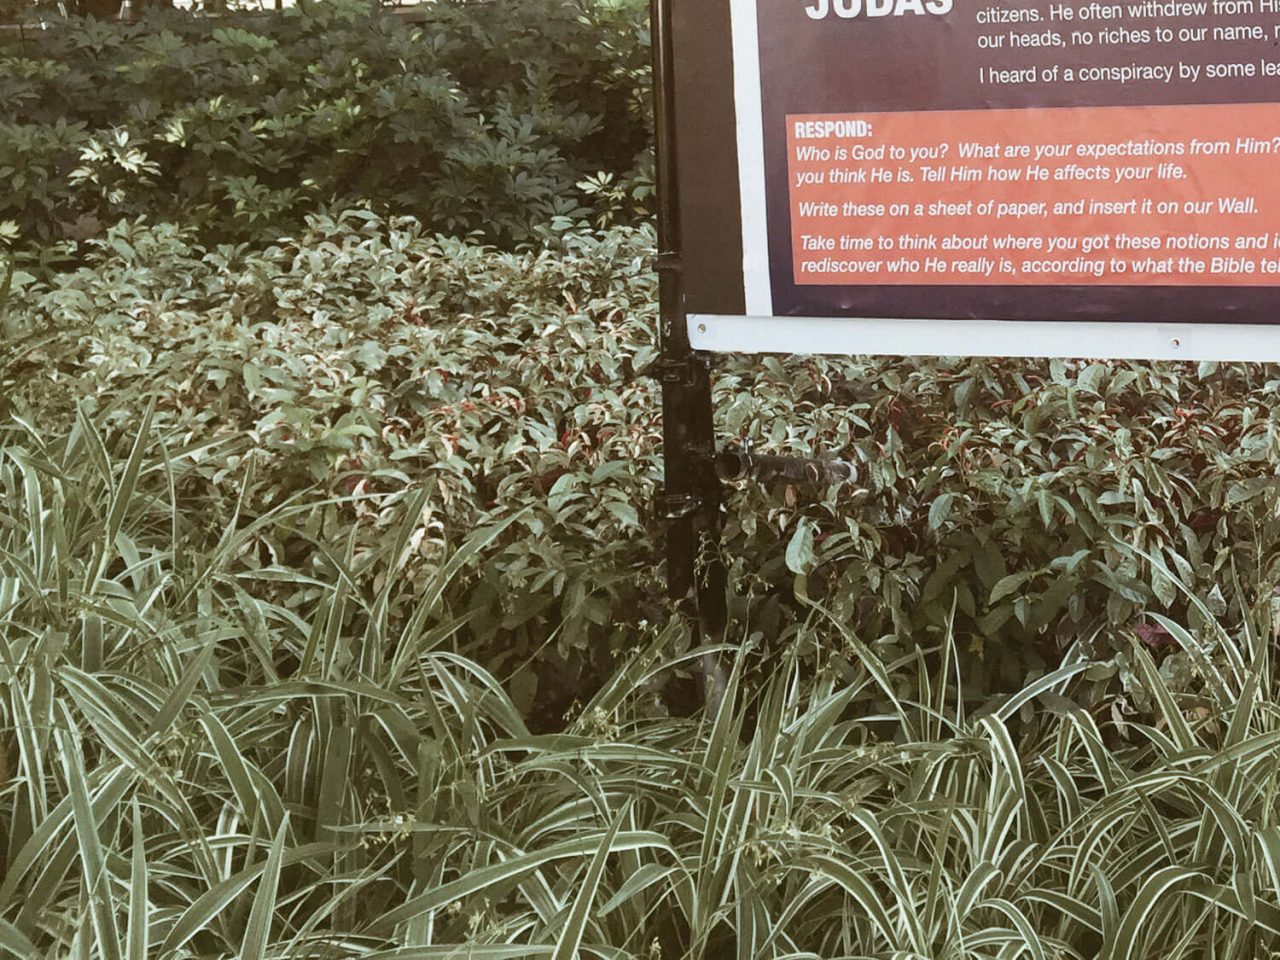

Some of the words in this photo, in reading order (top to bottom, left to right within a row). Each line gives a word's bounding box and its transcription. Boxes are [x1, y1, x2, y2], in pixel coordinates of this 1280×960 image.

[795, 120, 872, 139] RESPOND:
[796, 172, 824, 188] you
[829, 168, 866, 183] think
[870, 167, 893, 182] He
[897, 167, 914, 182] is.
[920, 166, 946, 182] Tell
[950, 166, 982, 182] Him
[987, 165, 1022, 181] how
[1026, 165, 1049, 180] He
[1054, 164, 1110, 180] affects
[1114, 167, 1154, 184] your
[1158, 163, 1187, 179] life.
[799, 202, 838, 217] Write
[842, 202, 885, 216] these
[889, 204, 909, 216] on
[914, 204, 924, 216] a
[928, 200, 973, 216] sheet
[976, 199, 994, 215] of
[997, 202, 1048, 219] paper,
[1053, 199, 1085, 214] and
[1089, 199, 1137, 214] insert
[1141, 198, 1152, 214] it
[1157, 202, 1178, 214] on
[1184, 202, 1214, 214] our
[1218, 197, 1258, 214] Wall.
[800, 235, 835, 250] Take
[840, 234, 873, 250] time
[878, 236, 894, 250] to
[898, 234, 937, 250] think
[942, 234, 989, 250] about
[992, 234, 1042, 249] where
[1047, 237, 1078, 253] you
[1082, 234, 1110, 253] got
[1115, 234, 1161, 249] these
[1166, 233, 1230, 249] notions
[1235, 233, 1268, 249] and
[801, 257, 883, 273] rediscover
[886, 257, 920, 272] who
[924, 257, 947, 272] He
[951, 257, 995, 276] really
[999, 257, 1016, 275] is,
[1021, 256, 1105, 276] according
[1110, 258, 1126, 273] to
[1132, 257, 1174, 273] what
[1178, 257, 1206, 273] the
[1210, 257, 1255, 273] Bible
